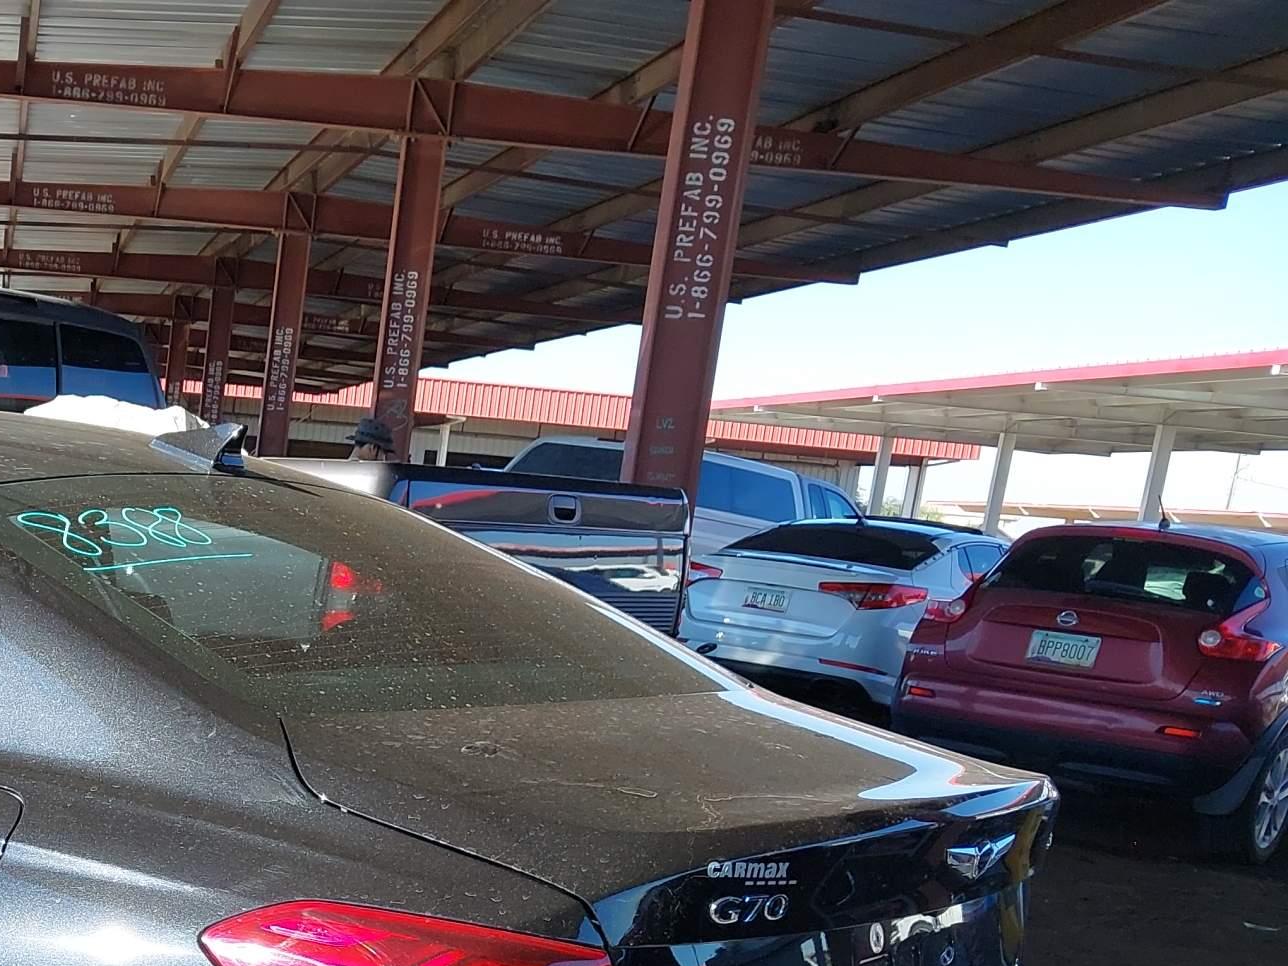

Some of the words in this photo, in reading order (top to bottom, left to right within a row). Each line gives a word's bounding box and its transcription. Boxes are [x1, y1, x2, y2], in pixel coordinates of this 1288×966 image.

[85, 73, 136, 90] PREFAB
[690, 115, 714, 159] INC.
[674, 172, 703, 262] PREFAB
[688, 118, 736, 318] 1-866-799-0969
[393, 269, 406, 295] INC.
[665, 276, 688, 318] U.S.
[387, 302, 402, 355] PREFAB
[397, 271, 419, 388] 1-866-799-0969
[383, 362, 396, 388] U.S.
[1037, 639, 1097, 661] BPP8007
[709, 893, 789, 925] G70
